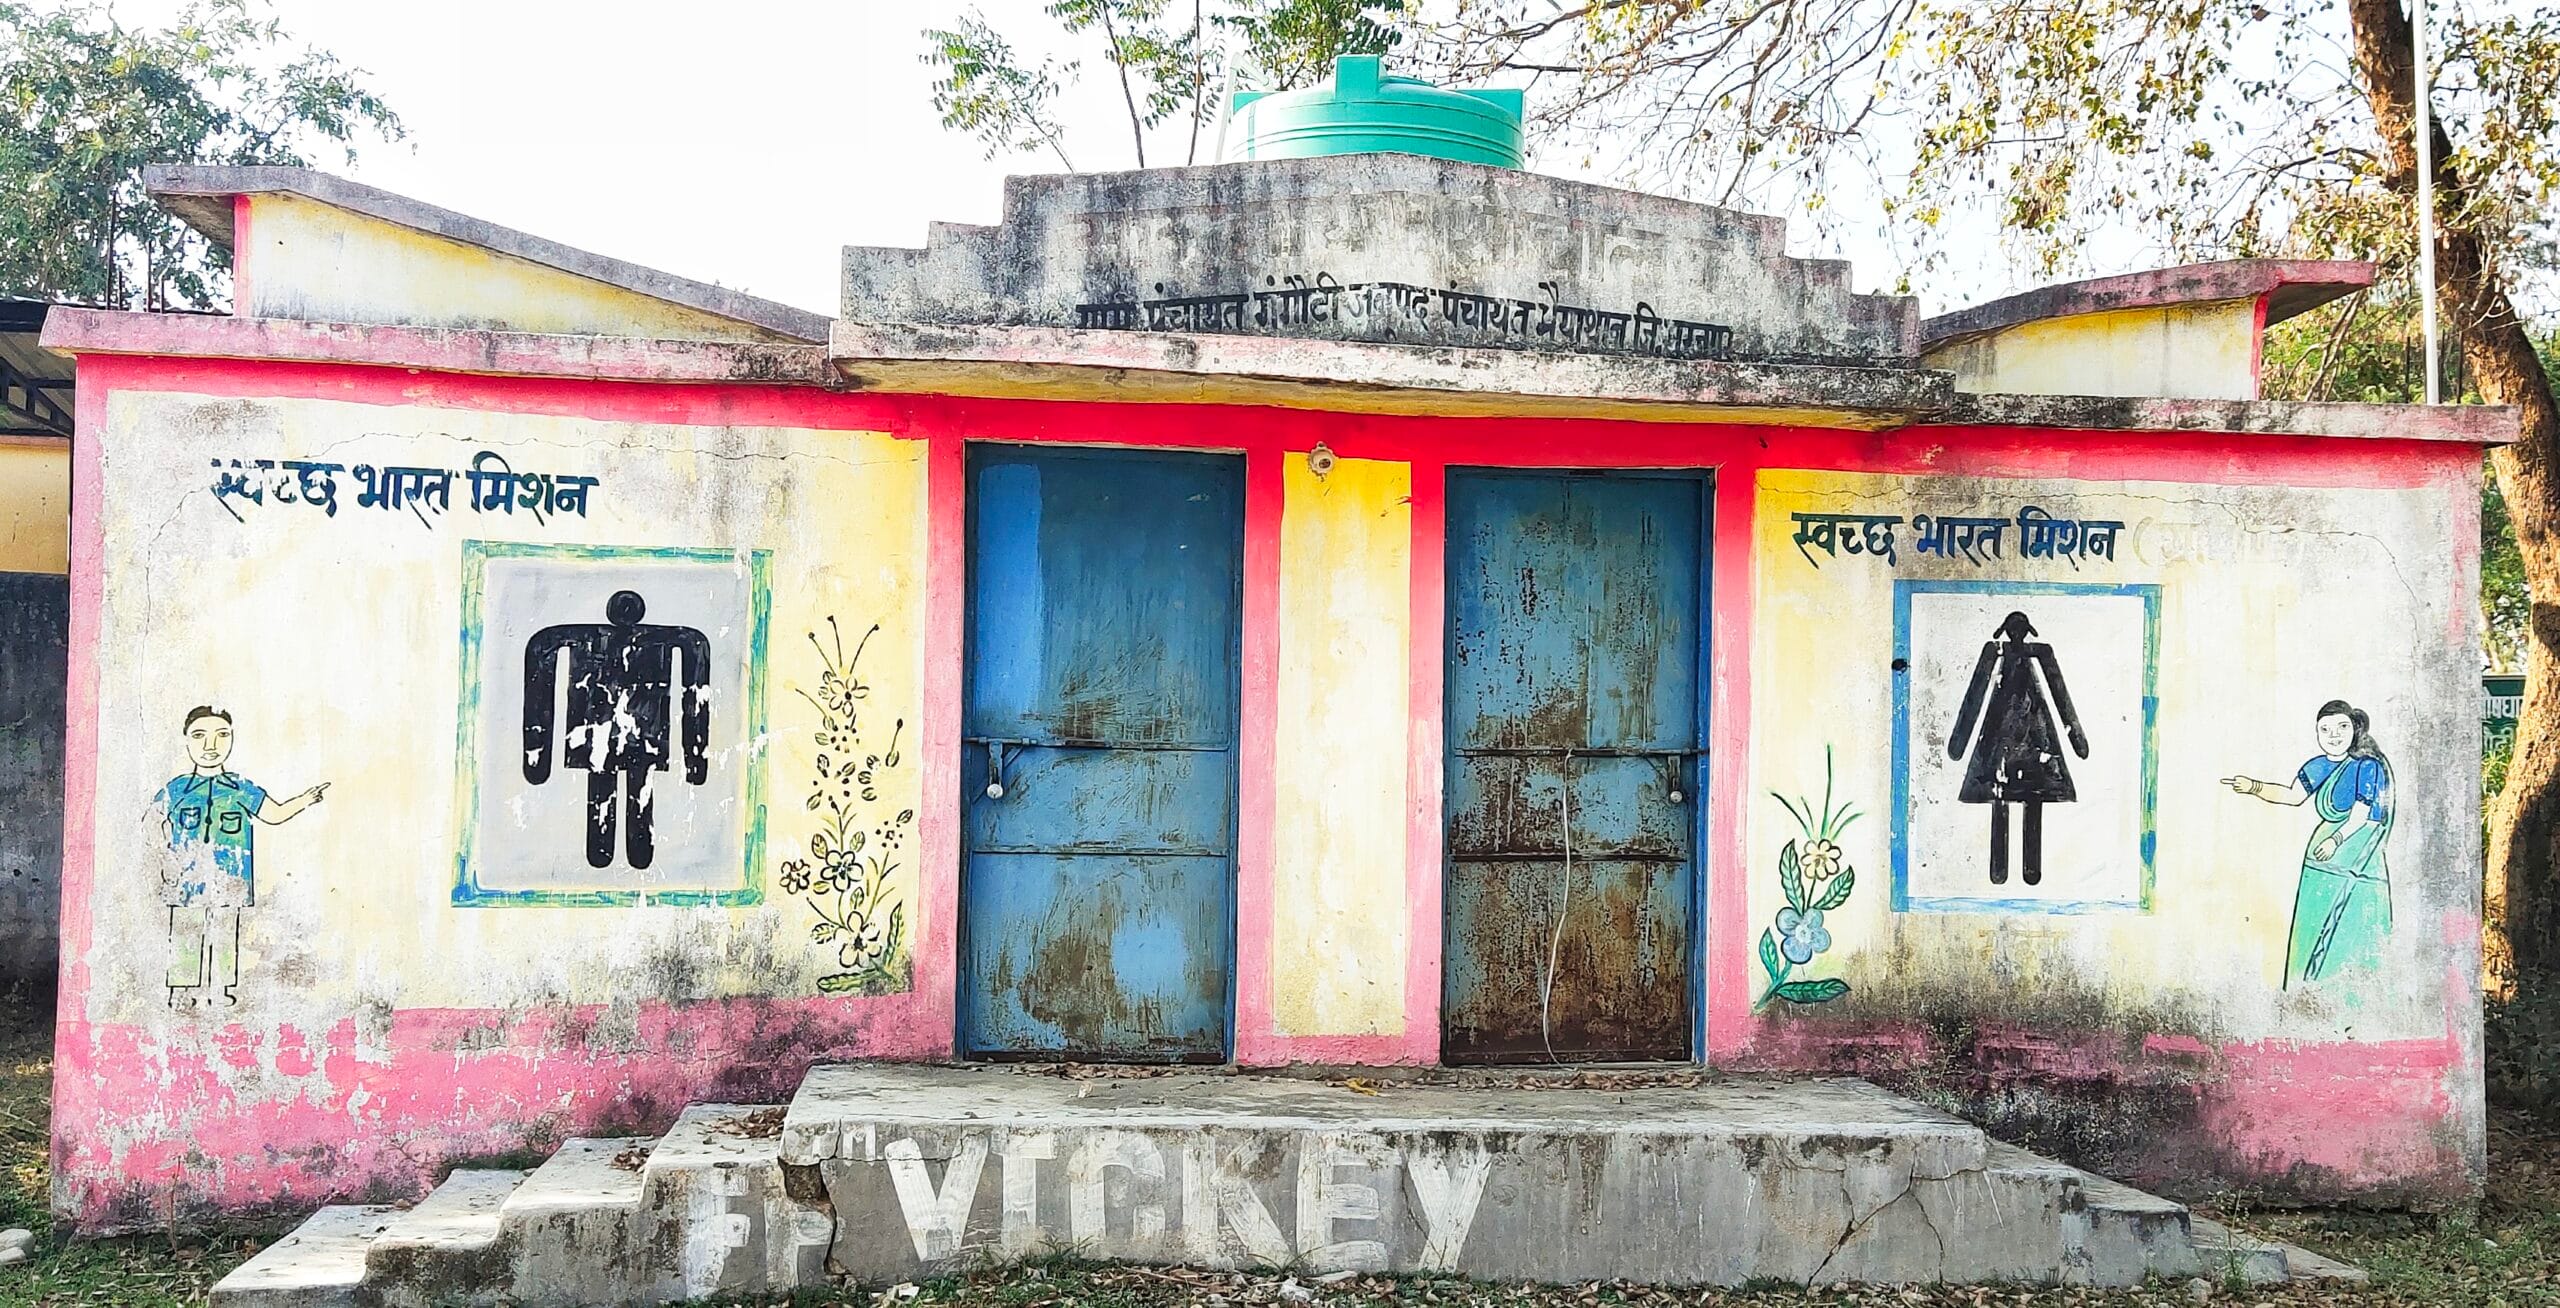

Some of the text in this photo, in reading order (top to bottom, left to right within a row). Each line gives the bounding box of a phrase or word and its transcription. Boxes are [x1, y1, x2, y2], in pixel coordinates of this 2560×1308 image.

[1439, 281, 1536, 335] पंचायत
[210, 451, 600, 530] स्वच्छ भारत मिशन
[1791, 511, 1904, 569] स्वच्छ
[1912, 513, 2011, 567] भारत
[2016, 505, 2125, 572] मिशन
[885, 1128, 1492, 1275] VICKEY
